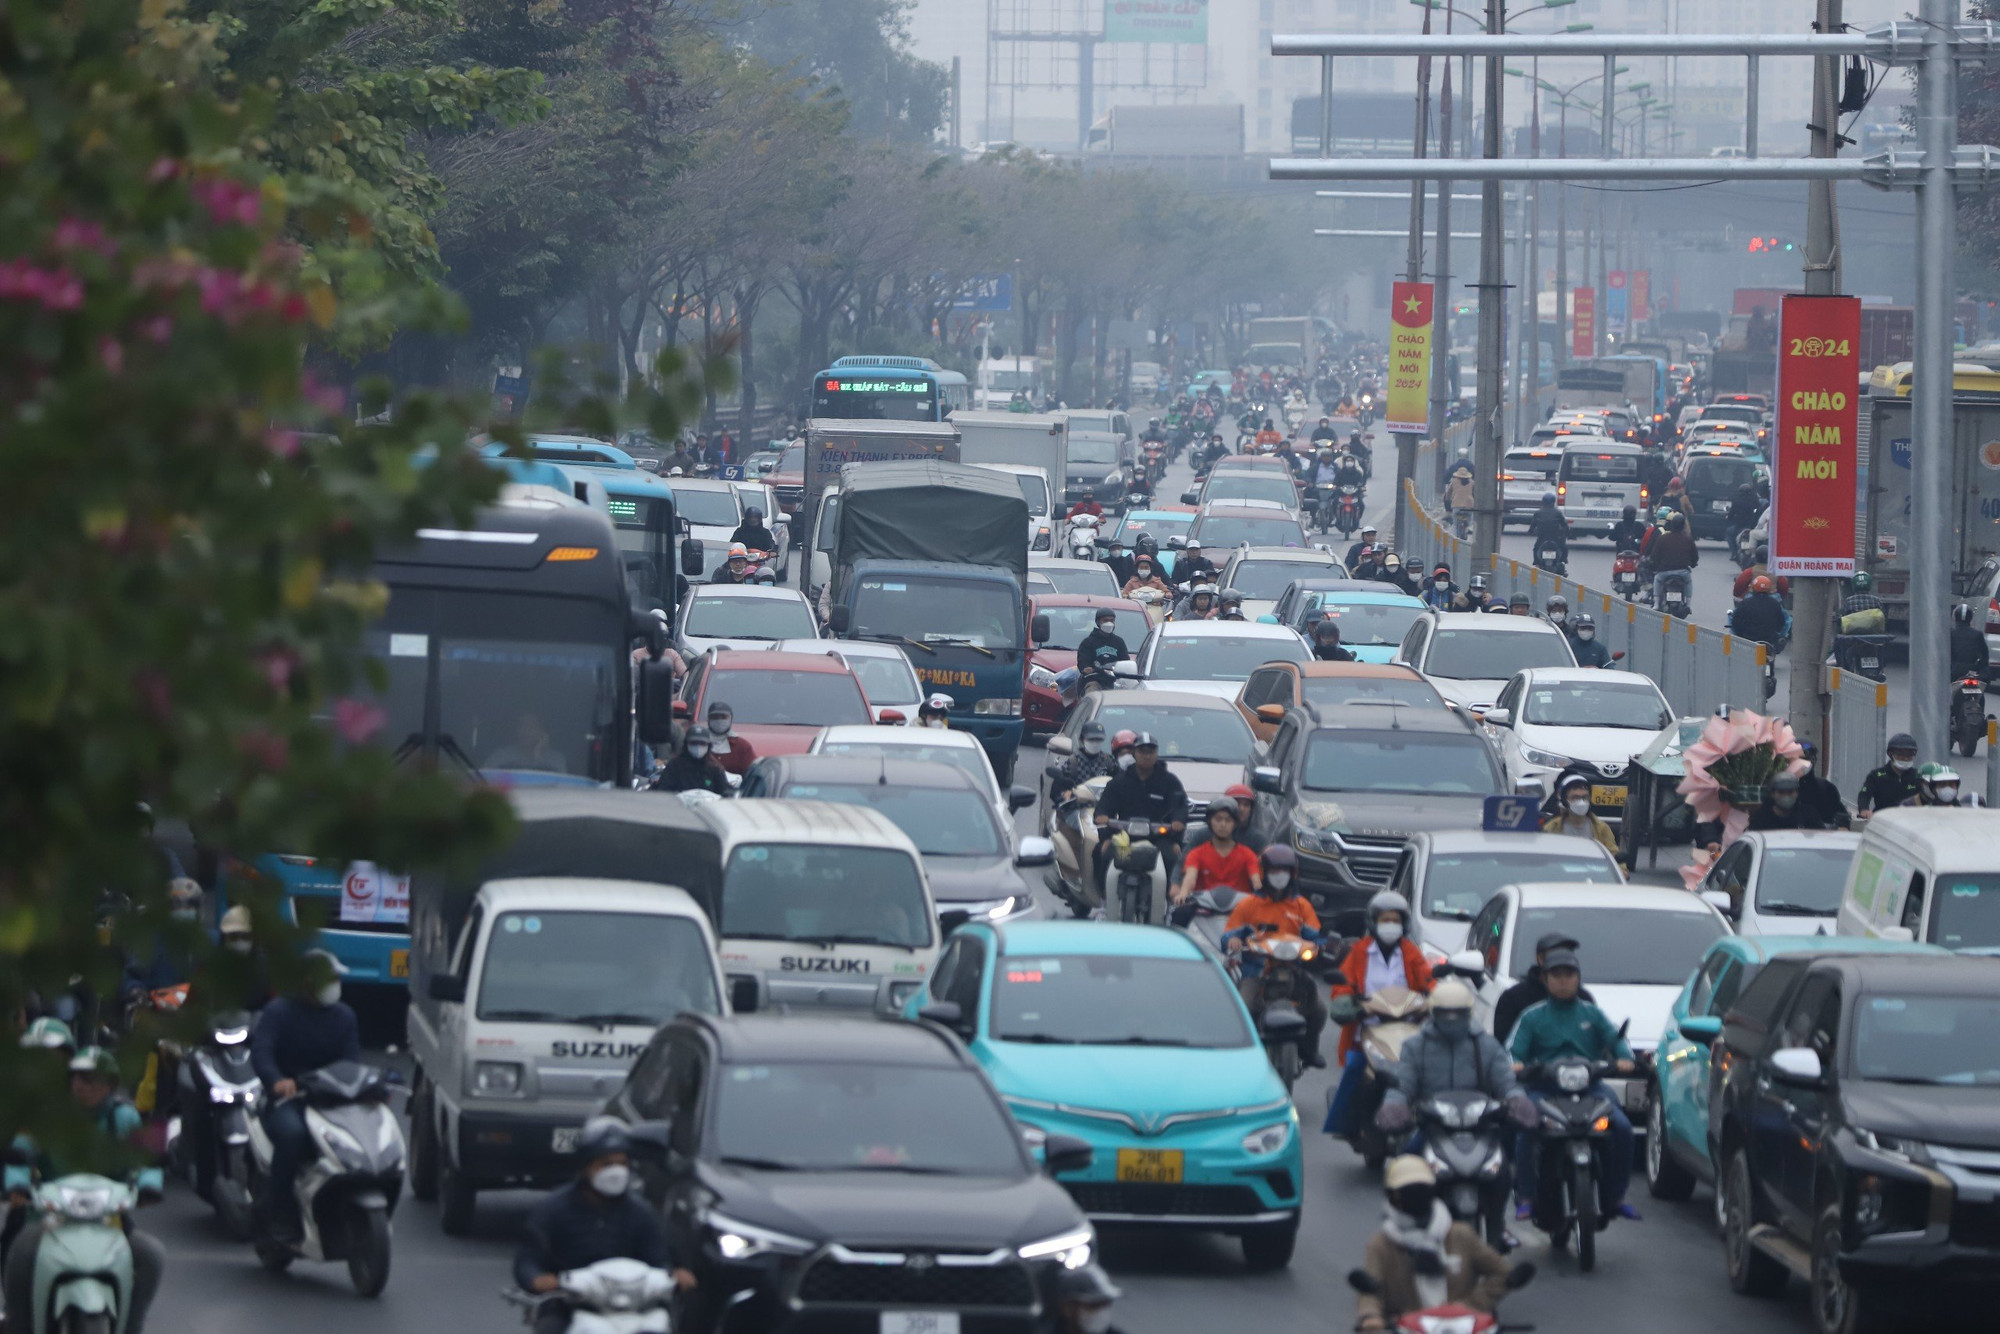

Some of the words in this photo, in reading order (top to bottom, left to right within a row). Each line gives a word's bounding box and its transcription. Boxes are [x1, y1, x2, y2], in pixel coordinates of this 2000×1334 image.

[1397, 333, 1425, 345] CHÀO
[1398, 347, 1422, 359] NĂM
[1399, 363, 1419, 374] MỚI
[1395, 378, 1422, 389] 2024
[1791, 387, 1846, 411] CHÀO
[1794, 423, 1842, 445] NĂM
[725, 466, 739, 480] G7
[1796, 456, 1838, 480] MỚI
[1778, 559, 1802, 571] QUẬN
[1803, 558, 1834, 571] HOÀNG
[1835, 561, 1853, 571] MAI
[1497, 800, 1526, 828] G7
[780, 956, 870, 973] SUZUKI
